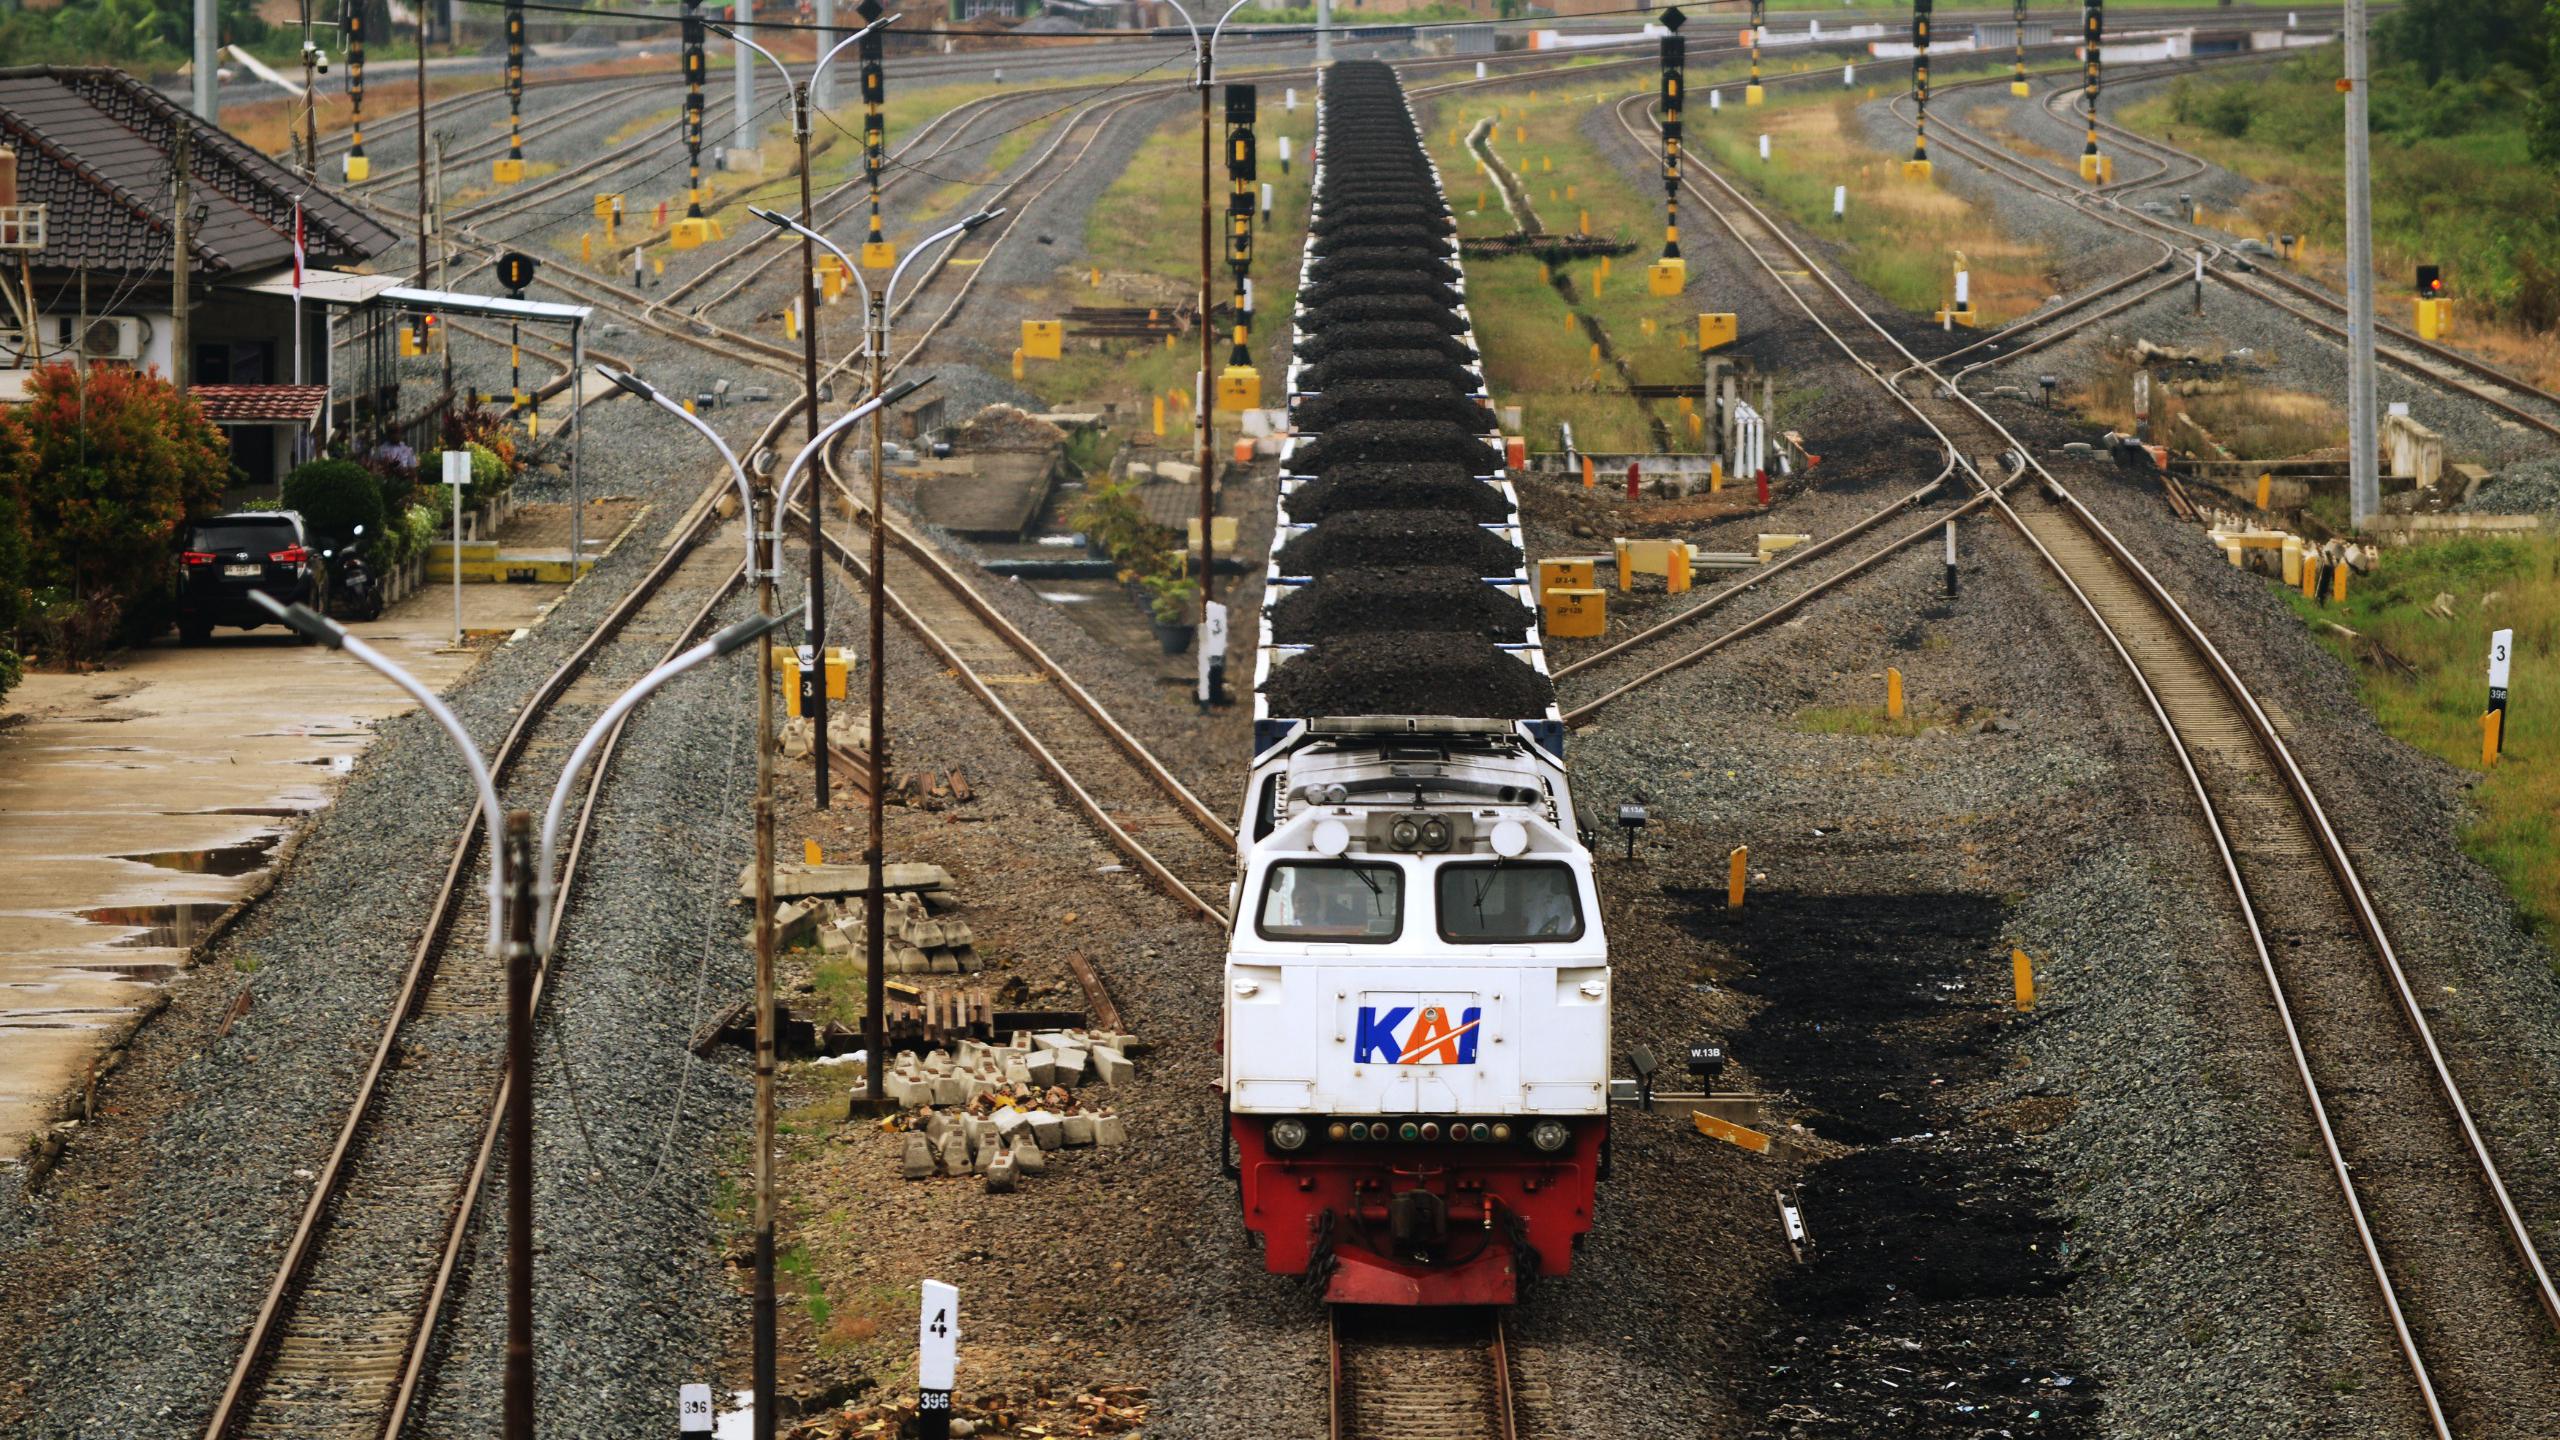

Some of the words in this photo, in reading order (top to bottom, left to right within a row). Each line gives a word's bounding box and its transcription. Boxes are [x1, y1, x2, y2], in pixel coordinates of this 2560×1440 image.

[2496, 644, 2505, 662] 3
[803, 681, 813, 697] 3
[2490, 689, 2507, 699] 396
[1354, 1007, 1481, 1064] KAI
[1691, 1048, 1720, 1057] W.13B
[929, 1308, 947, 1338] 4
[684, 1401, 708, 1414] 396
[921, 1392, 949, 1410] 396
